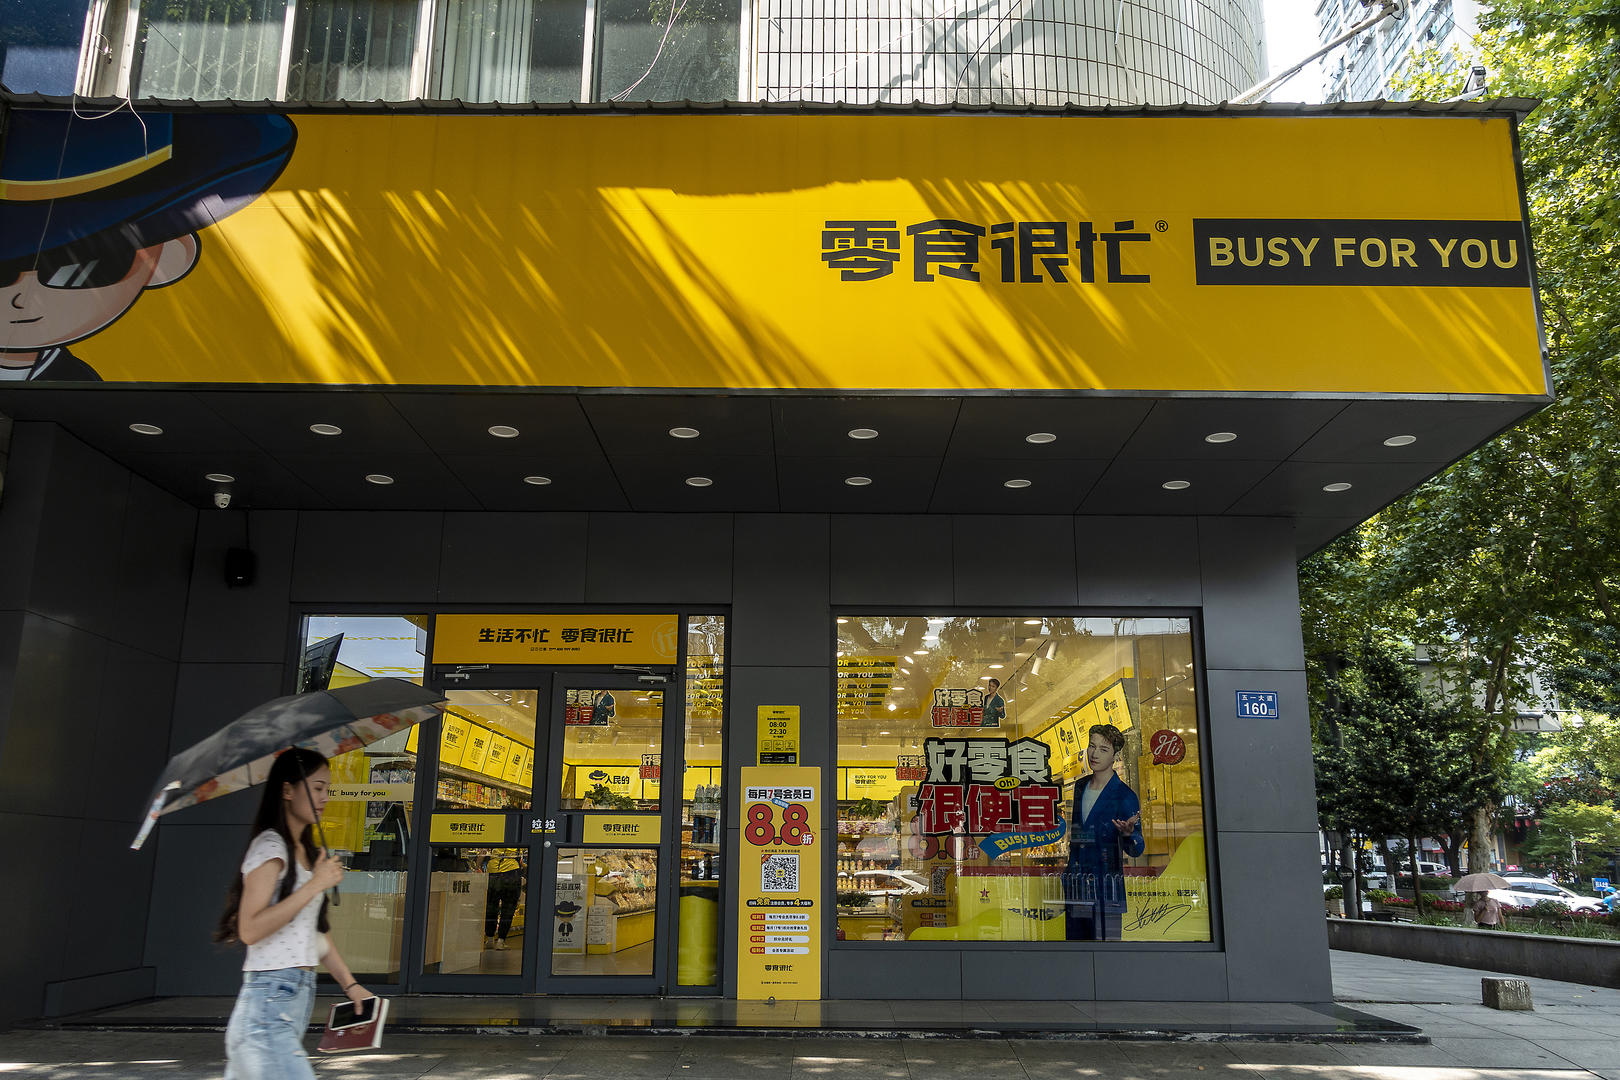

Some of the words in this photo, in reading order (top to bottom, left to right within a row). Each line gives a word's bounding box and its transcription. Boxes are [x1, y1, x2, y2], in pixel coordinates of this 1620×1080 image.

[821, 219, 1151, 283] 零食很忙
[1209, 237, 1320, 267] BUSY
[1333, 237, 1418, 267] FOR
[1428, 238, 1519, 269] YOU
[478, 628, 550, 643] 生活不忙
[561, 628, 634, 643] 零食很忙
[935, 690, 982, 706] 好零食
[933, 706, 983, 726] 很便宜
[1244, 702, 1267, 715] 160
[1154, 735, 1180, 756] Hi
[927, 741, 1049, 783] 好零食
[605, 776, 629, 784] 人民的
[1000, 779, 1015, 788] Oh!
[341, 789, 358, 797] busy
[748, 789, 811, 799] 每月7号会员日
[919, 784, 1060, 834] 很便宜
[532, 819, 542, 829] 拉
[545, 819, 555, 829] 拉
[745, 803, 811, 847] 8.8
[1030, 834, 1045, 843] For
[1045, 829, 1060, 841] You
